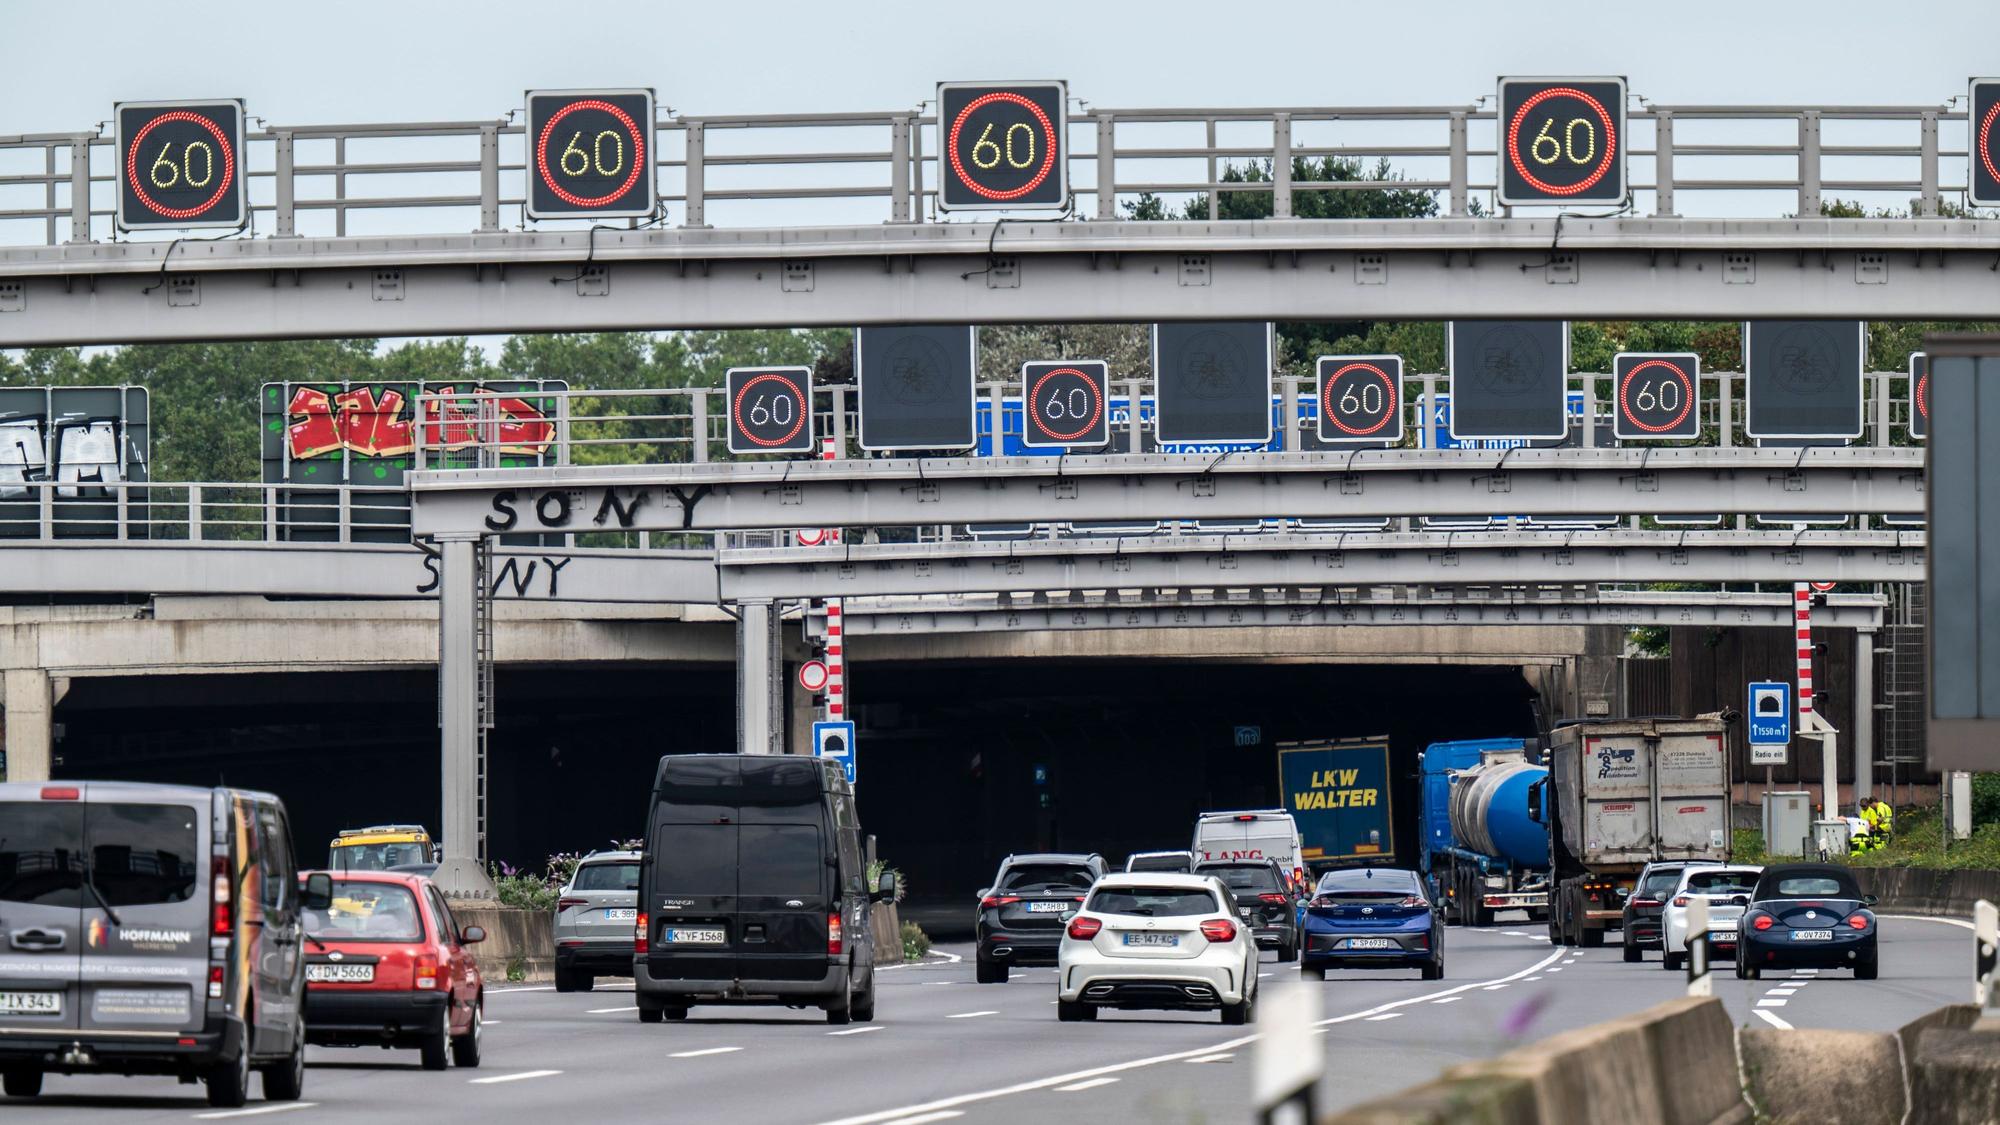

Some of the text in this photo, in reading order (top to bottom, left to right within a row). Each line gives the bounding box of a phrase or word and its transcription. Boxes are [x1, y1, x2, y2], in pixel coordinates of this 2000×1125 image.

[561, 130, 623, 177] 60
[972, 123, 1035, 169] 60
[1532, 118, 1595, 165] 60
[151, 141, 213, 189] 60
[750, 394, 792, 426] 60
[1046, 388, 1088, 420] 60
[1340, 384, 1382, 415] 60
[1637, 381, 1679, 412] 60
[485, 485, 712, 531] SONY
[416, 553, 571, 597] SNY
[1240, 733, 1257, 745] 103
[1759, 727, 1773, 736] 1550
[1311, 769, 1359, 788] LKW
[1294, 788, 1378, 810] WALTER
[119, 929, 191, 943] HOFFMANN
[700, 931, 723, 941] 1568
[342, 967, 371, 978] 5666
[27, 994, 53, 1008] 343
